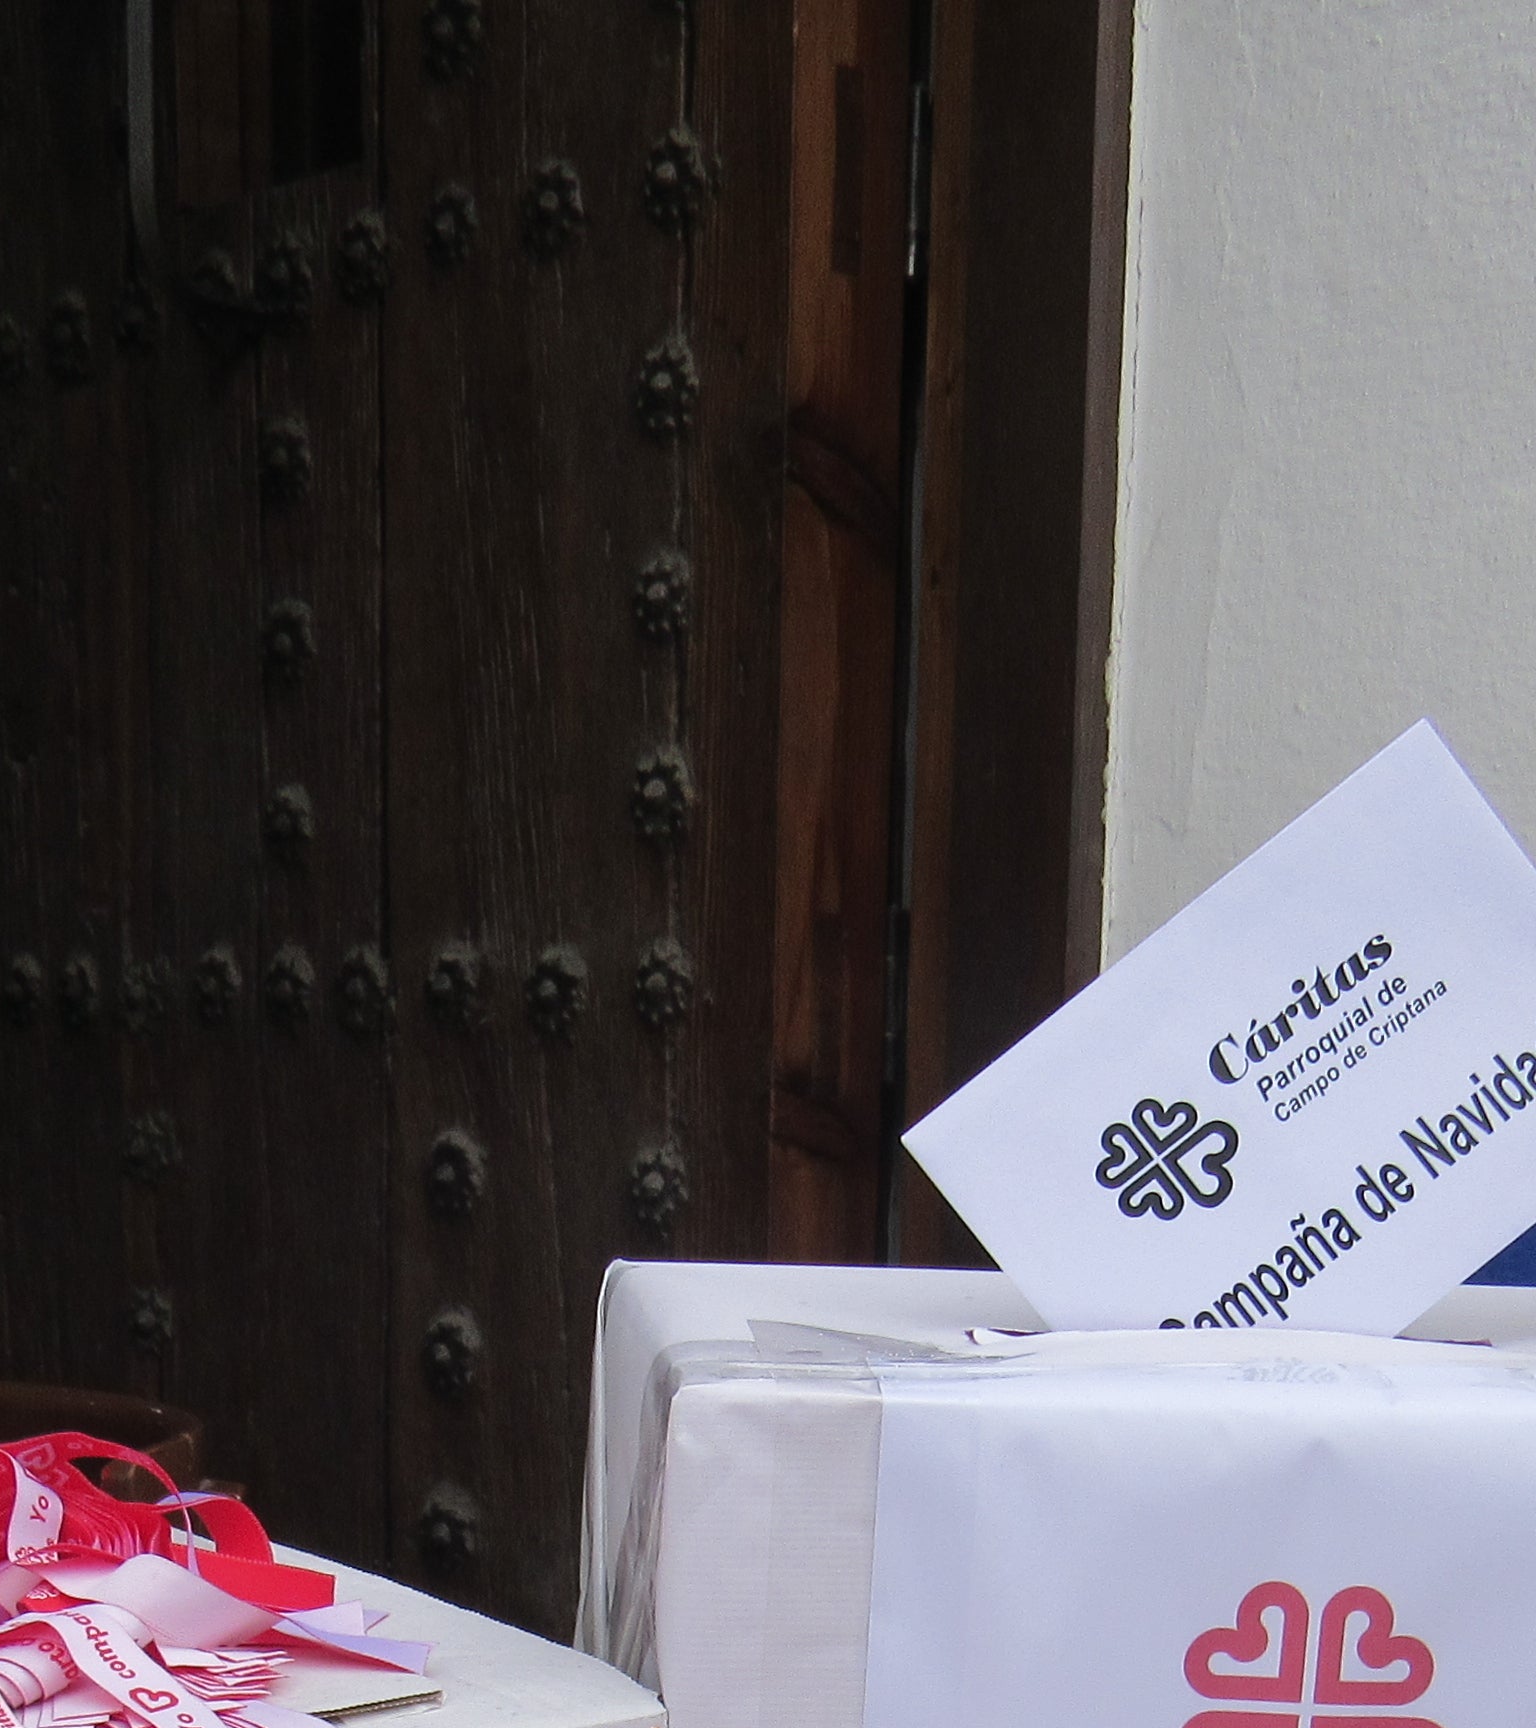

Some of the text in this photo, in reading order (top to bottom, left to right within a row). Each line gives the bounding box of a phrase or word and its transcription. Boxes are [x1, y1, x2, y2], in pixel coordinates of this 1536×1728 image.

[1209, 934, 1392, 1084] Cáritas
[1256, 977, 1408, 1102] Parroquial de
[1274, 980, 1447, 1122] Campo de Criptana
[1158, 1207, 1362, 1330] ampaña
[1354, 1164, 1416, 1222] de
[29, 1495, 50, 1524] Yo
[63, 1610, 137, 1680] compar
